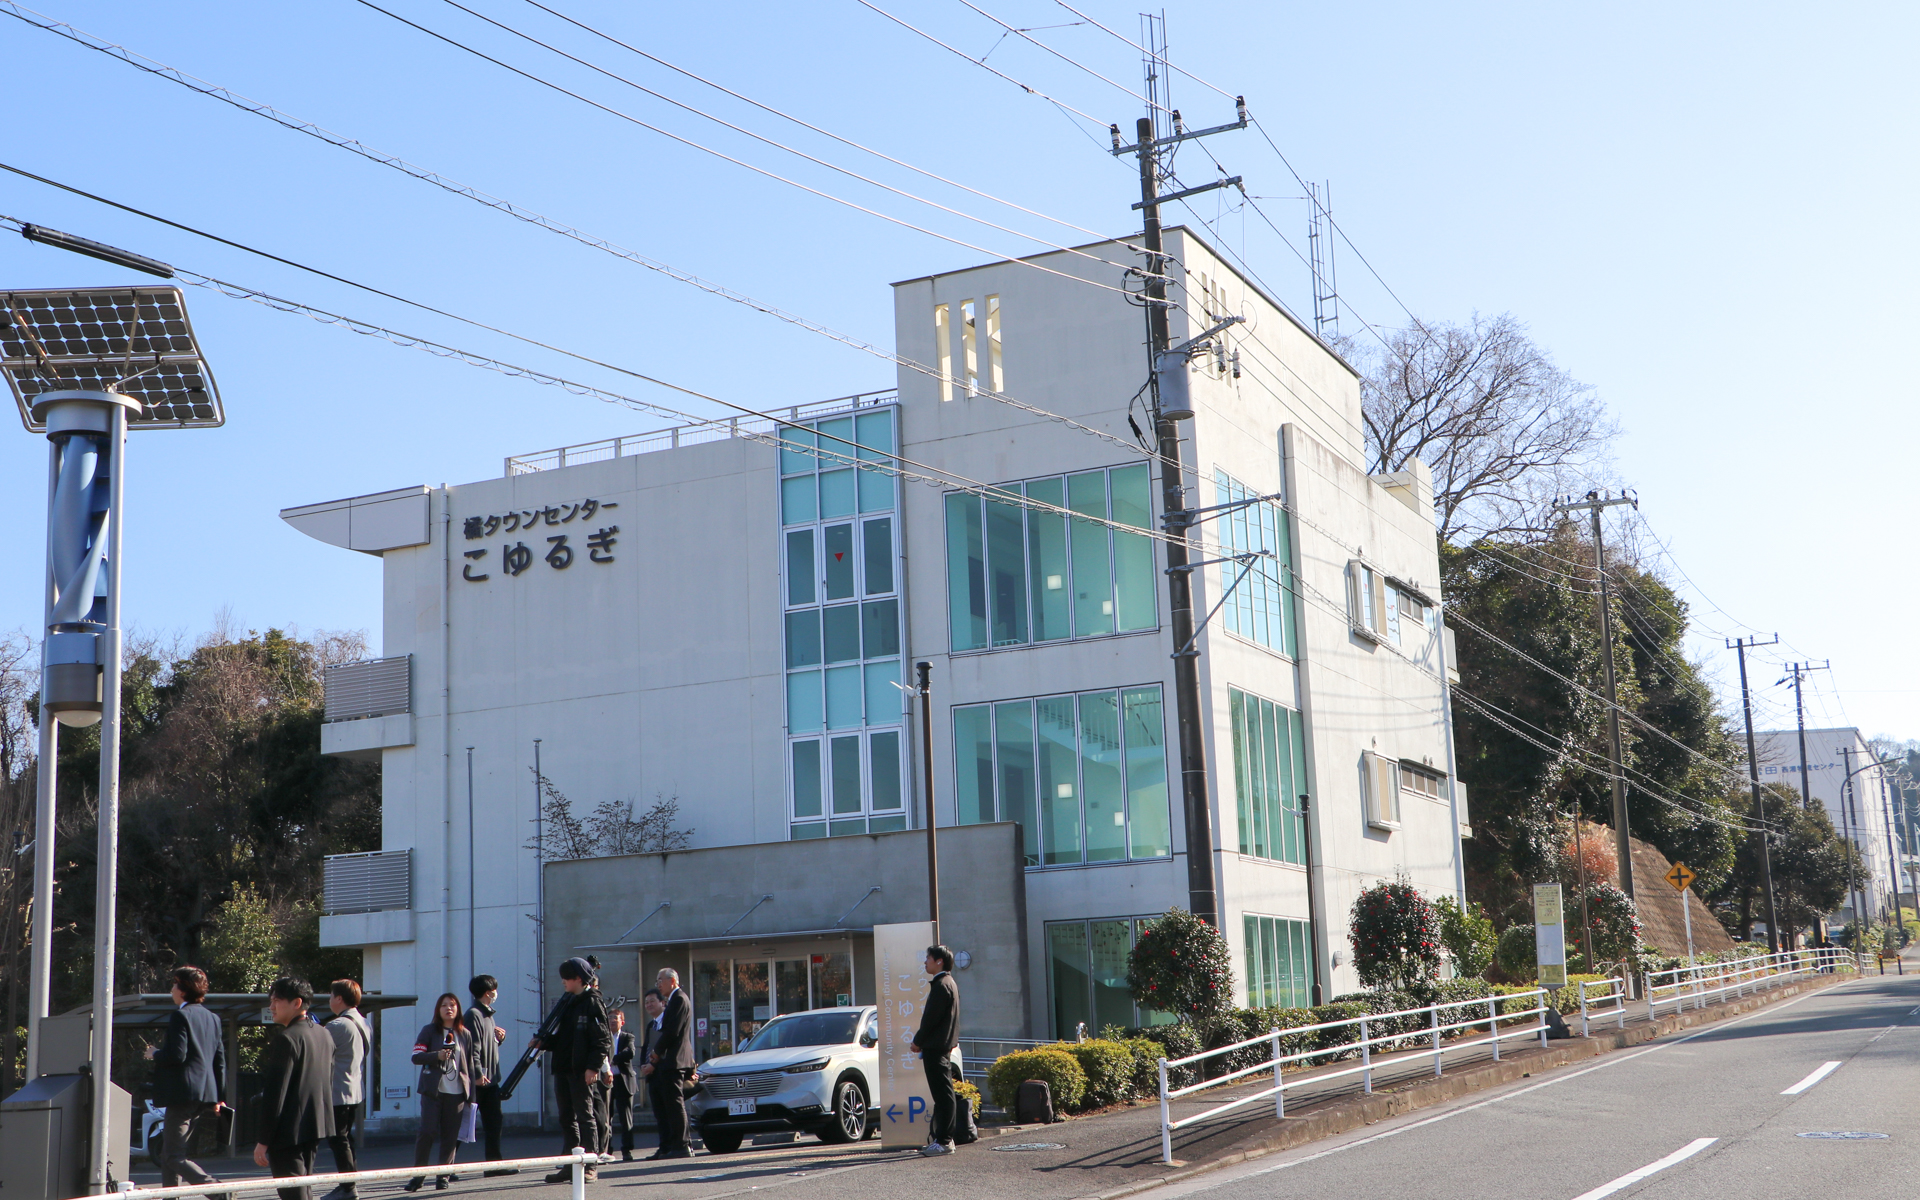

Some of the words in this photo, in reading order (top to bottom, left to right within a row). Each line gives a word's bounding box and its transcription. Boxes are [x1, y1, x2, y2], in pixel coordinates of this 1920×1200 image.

[463, 498, 618, 540] 橘タウンセンター
[463, 525, 619, 582] こゆるぎ
[885, 998, 895, 1055] Community
[899, 974, 914, 1070] こゆるぎ
[886, 1058, 895, 1092] Center
[908, 1096, 926, 1123] P
